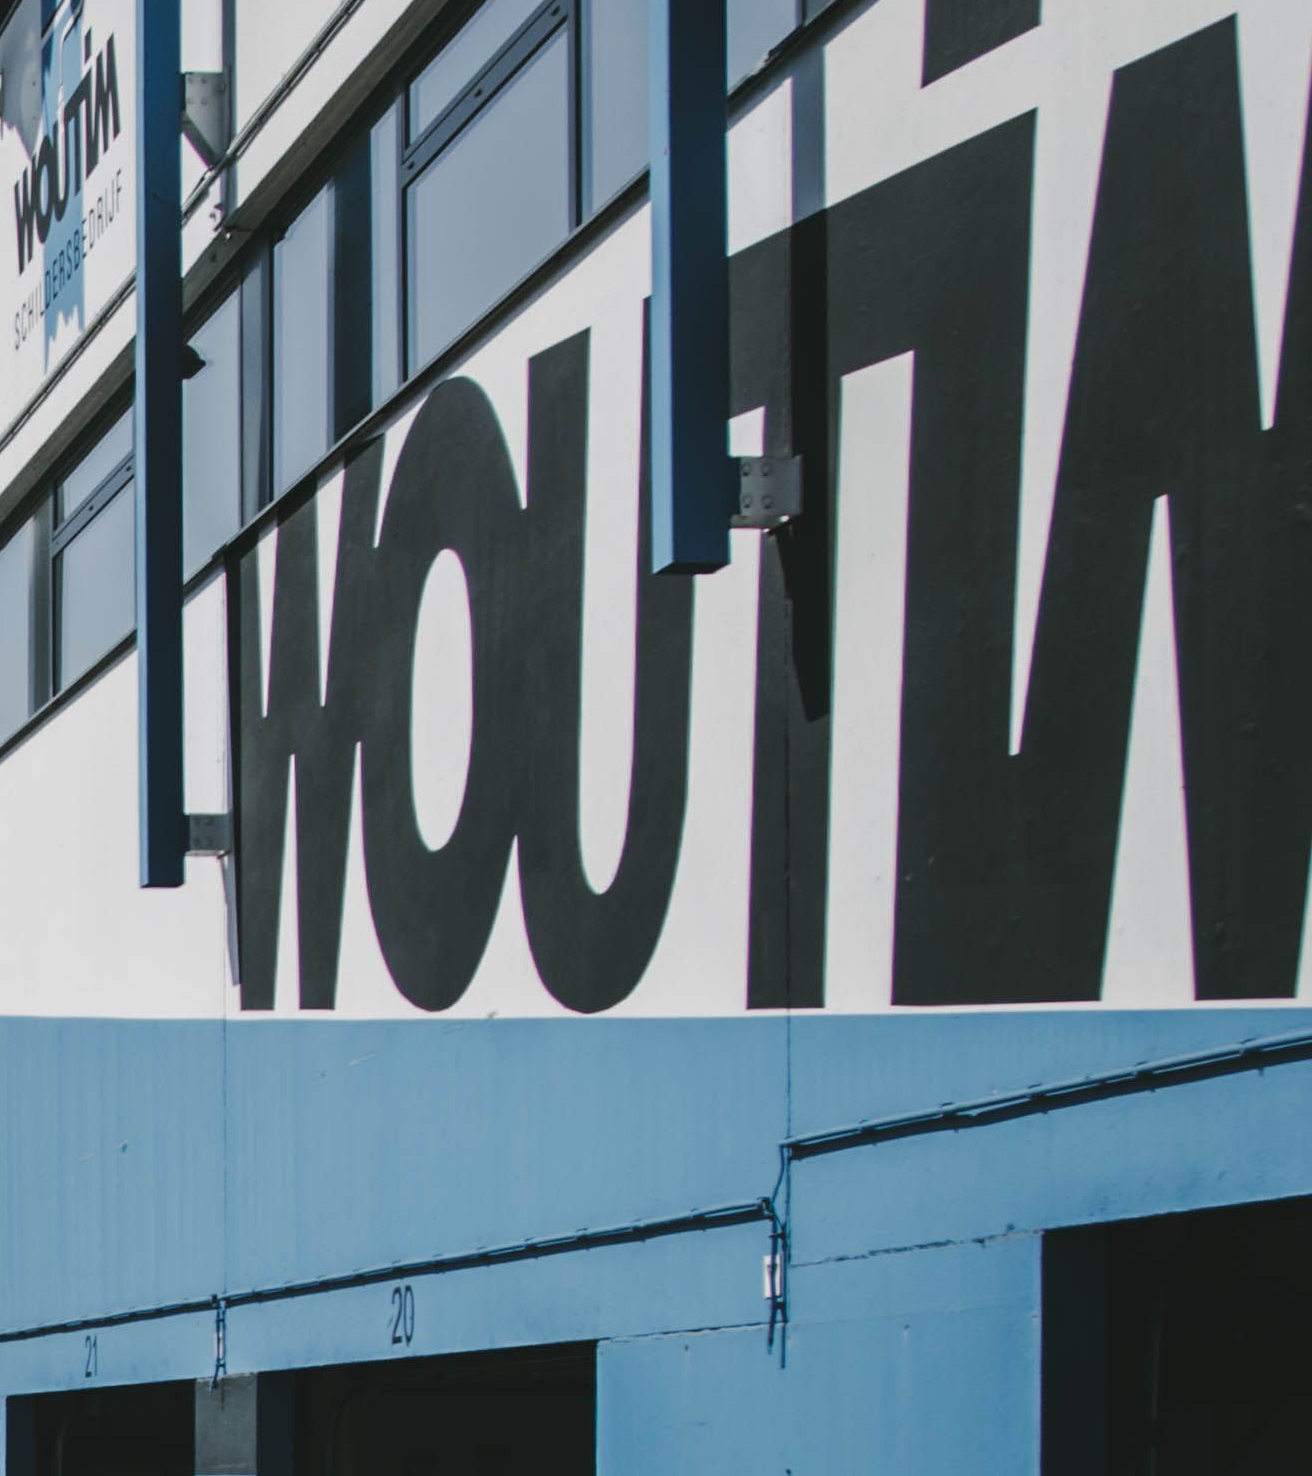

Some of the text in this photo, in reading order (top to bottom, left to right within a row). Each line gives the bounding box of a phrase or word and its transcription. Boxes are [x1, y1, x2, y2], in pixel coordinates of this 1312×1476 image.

[15, 168, 123, 348] SCHILDERSBEDRIJF
[390, 1284, 415, 1348] 20
[84, 1334, 98, 1379] 21
